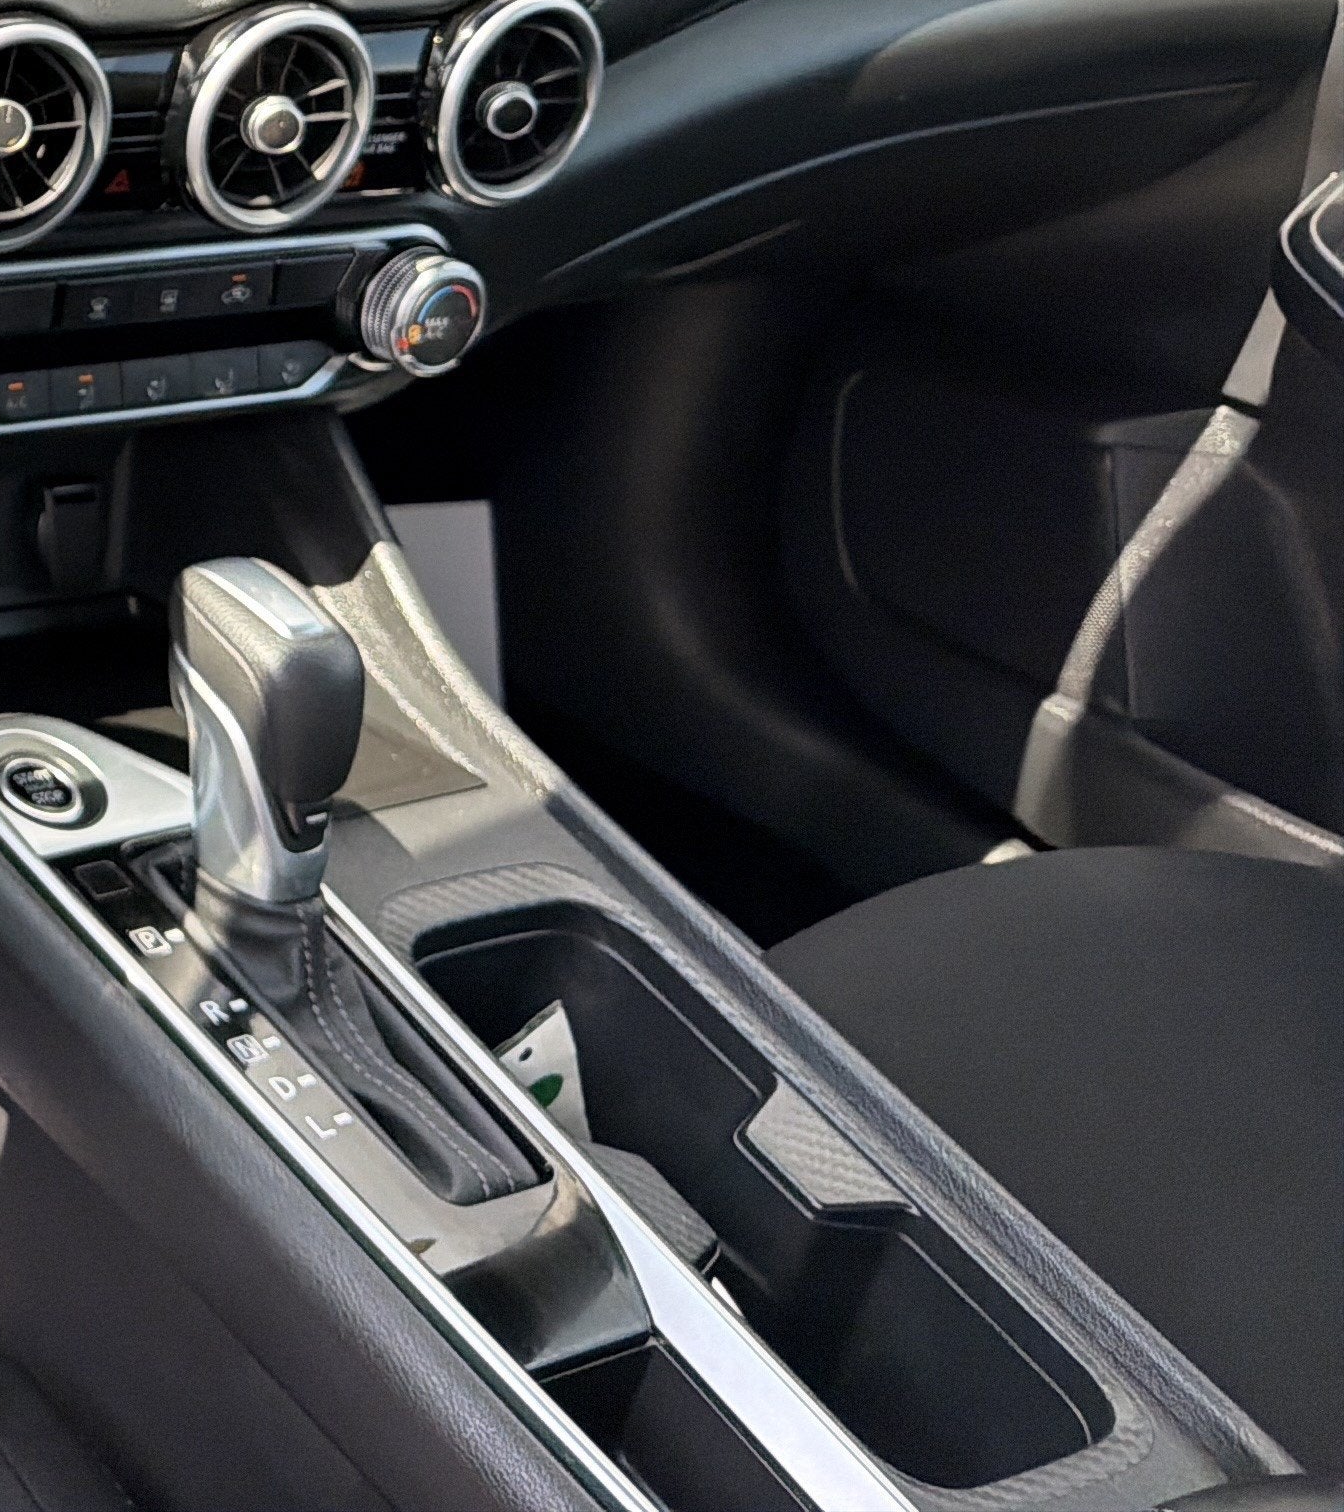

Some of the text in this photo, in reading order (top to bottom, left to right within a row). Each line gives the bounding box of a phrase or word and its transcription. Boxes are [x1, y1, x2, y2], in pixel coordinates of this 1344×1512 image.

[199, 1000, 230, 1026] R
[268, 1076, 297, 1101] D
[305, 1115, 338, 1140] L
